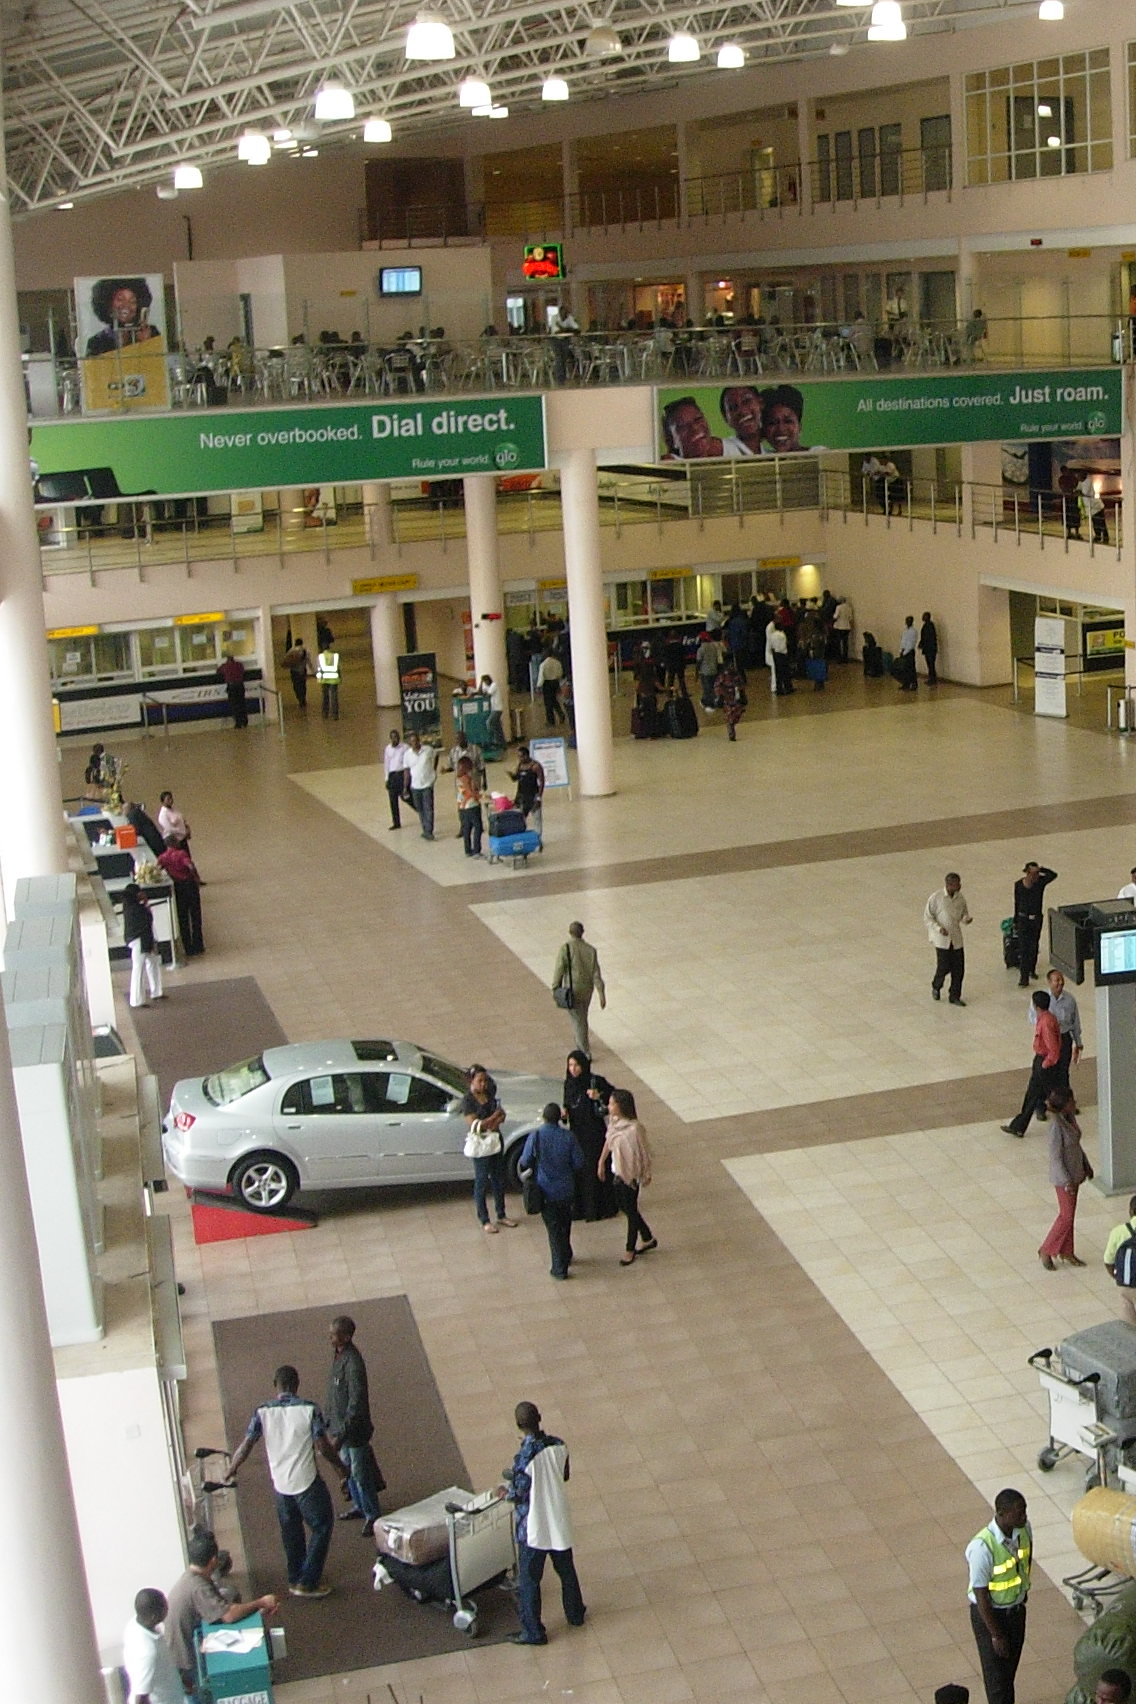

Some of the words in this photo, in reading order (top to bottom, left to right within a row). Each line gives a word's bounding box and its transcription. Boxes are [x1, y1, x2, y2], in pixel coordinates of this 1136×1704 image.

[857, 399, 873, 412] All
[876, 395, 950, 411] destinations
[953, 392, 1004, 408] covered.
[1009, 385, 1050, 404] Just
[1056, 385, 1109, 401] roam.
[199, 431, 253, 450] Never
[257, 424, 363, 446] overbooked.
[371, 413, 423, 440] Dial
[431, 408, 516, 436] direct.
[411, 456, 436, 468] Rule
[437, 458, 460, 470] your
[495, 449, 518, 466] glo
[404, 699, 436, 713] YOU
